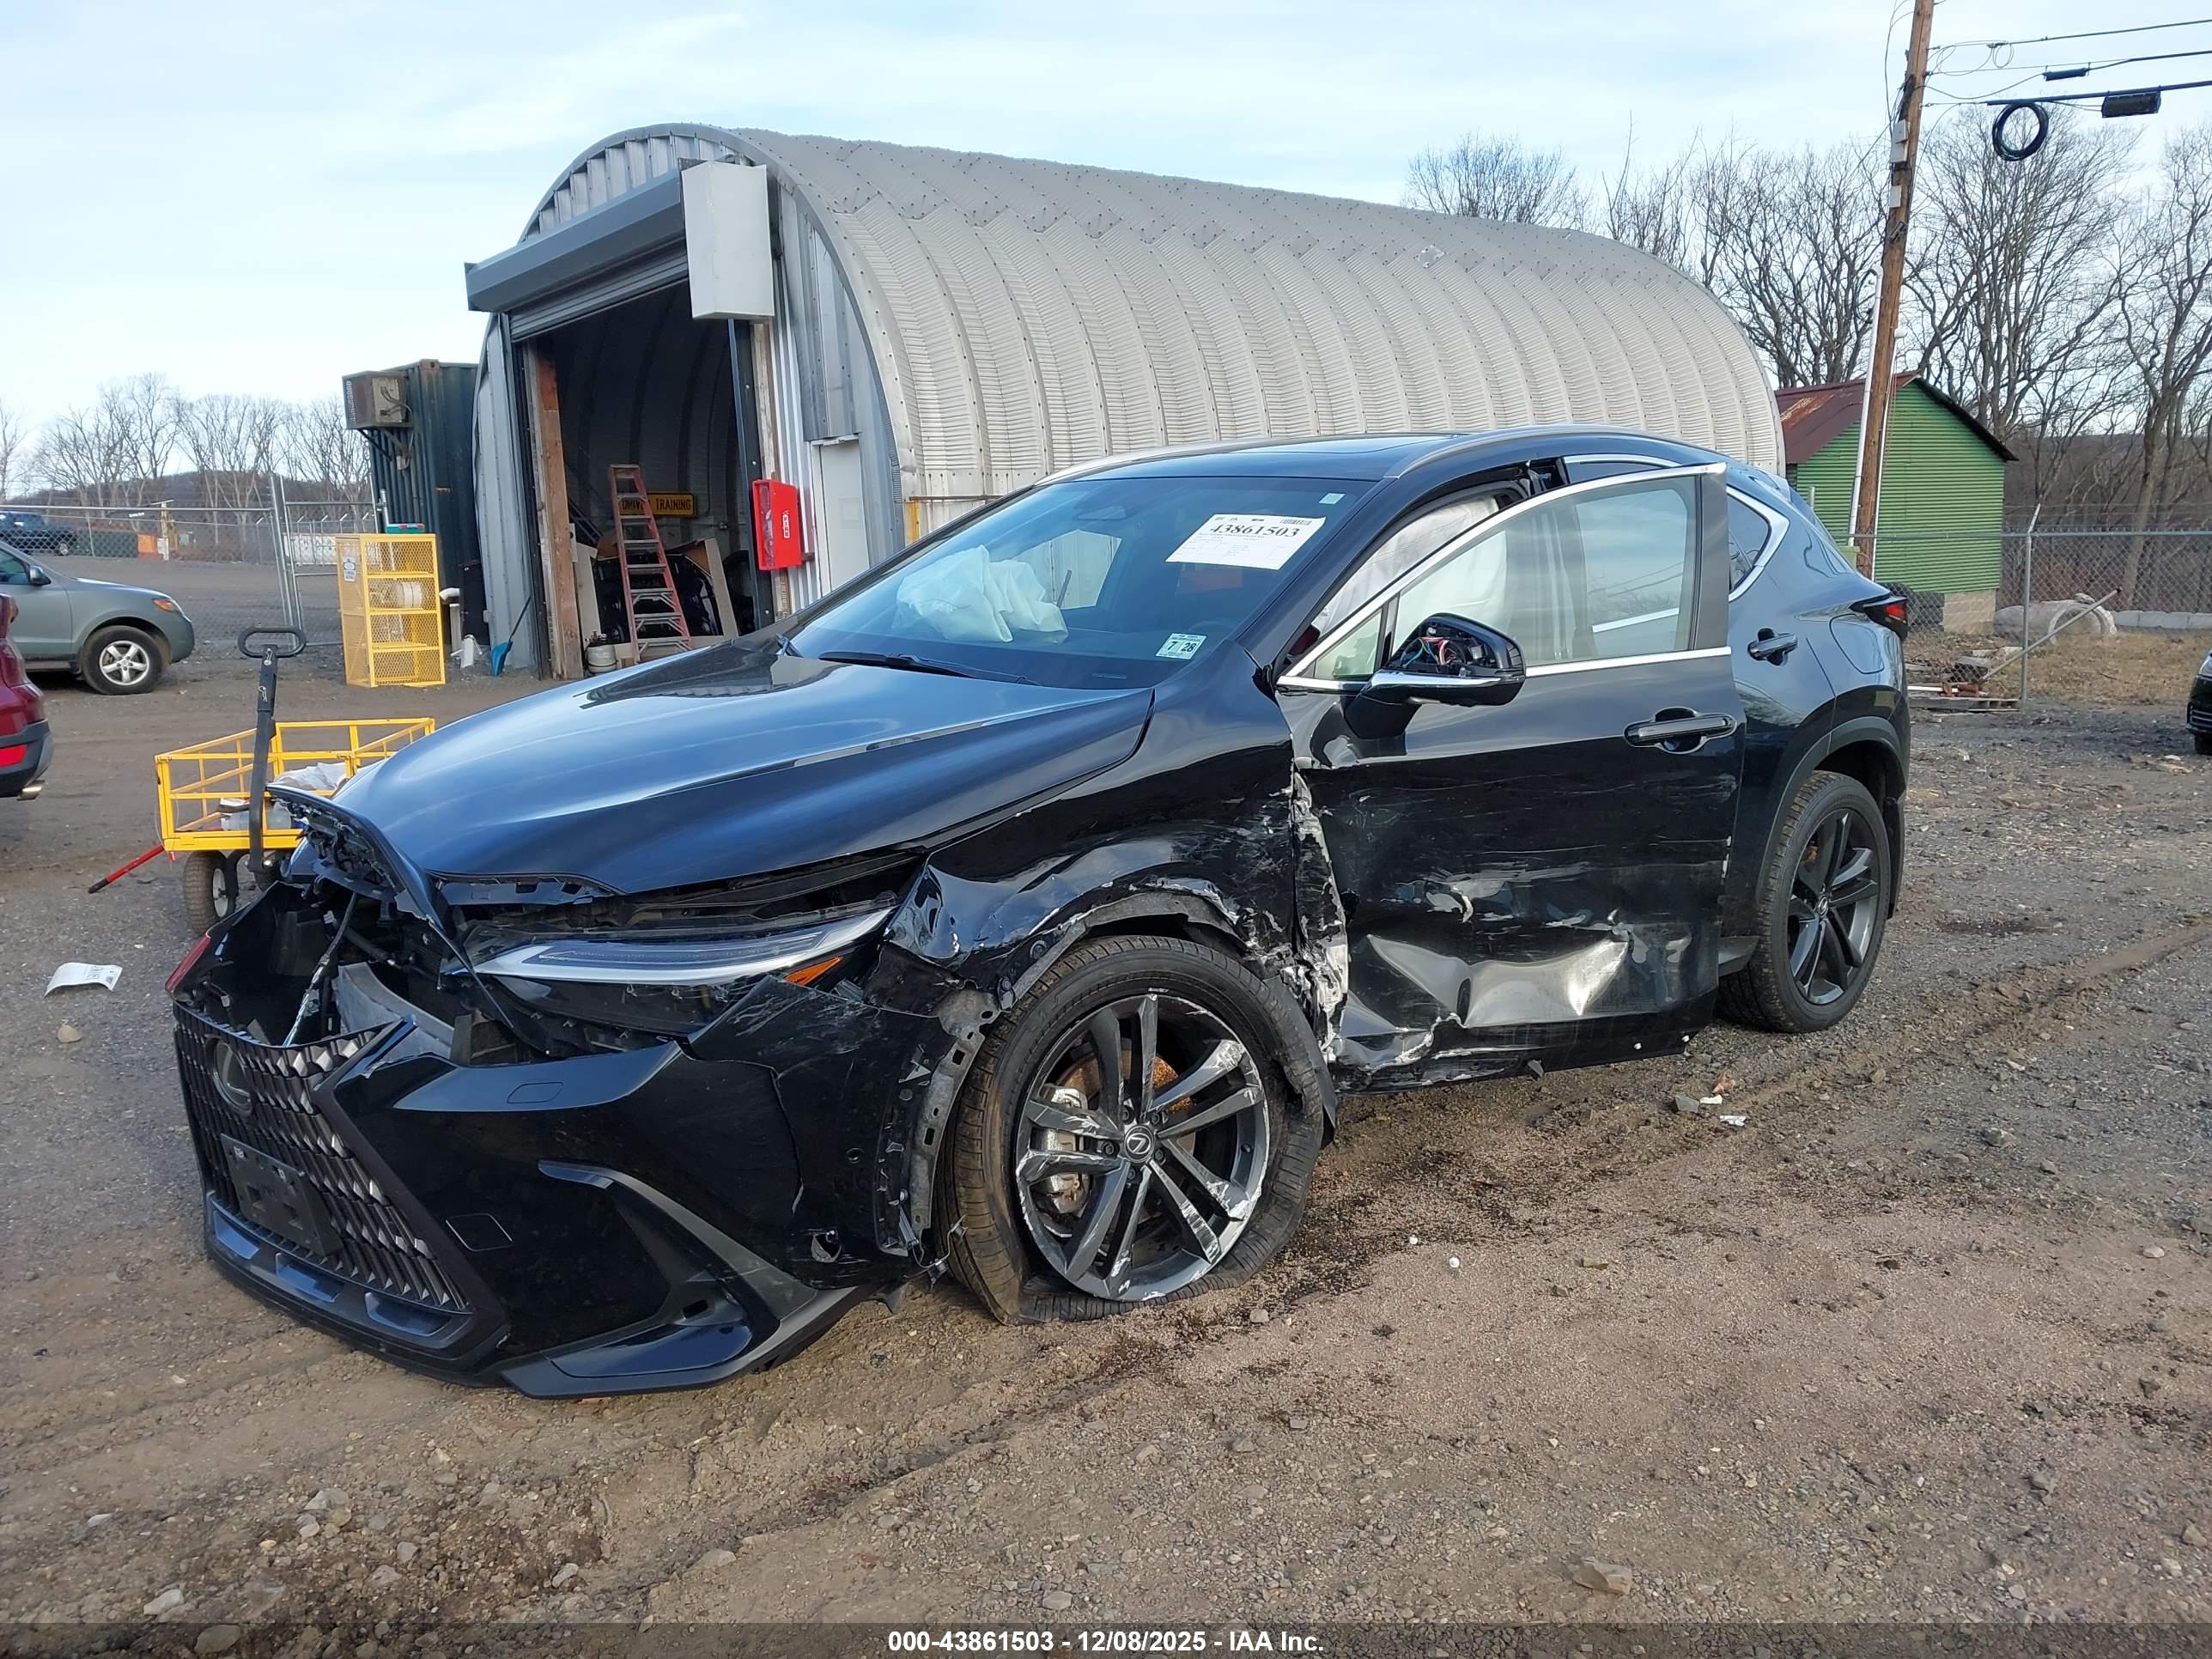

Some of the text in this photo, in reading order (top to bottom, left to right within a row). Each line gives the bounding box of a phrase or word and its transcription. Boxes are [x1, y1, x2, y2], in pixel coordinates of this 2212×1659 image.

[655, 498, 691, 511] TRAINING
[1210, 523, 1300, 538] 43861503
[1168, 641, 1197, 653] 7 28
